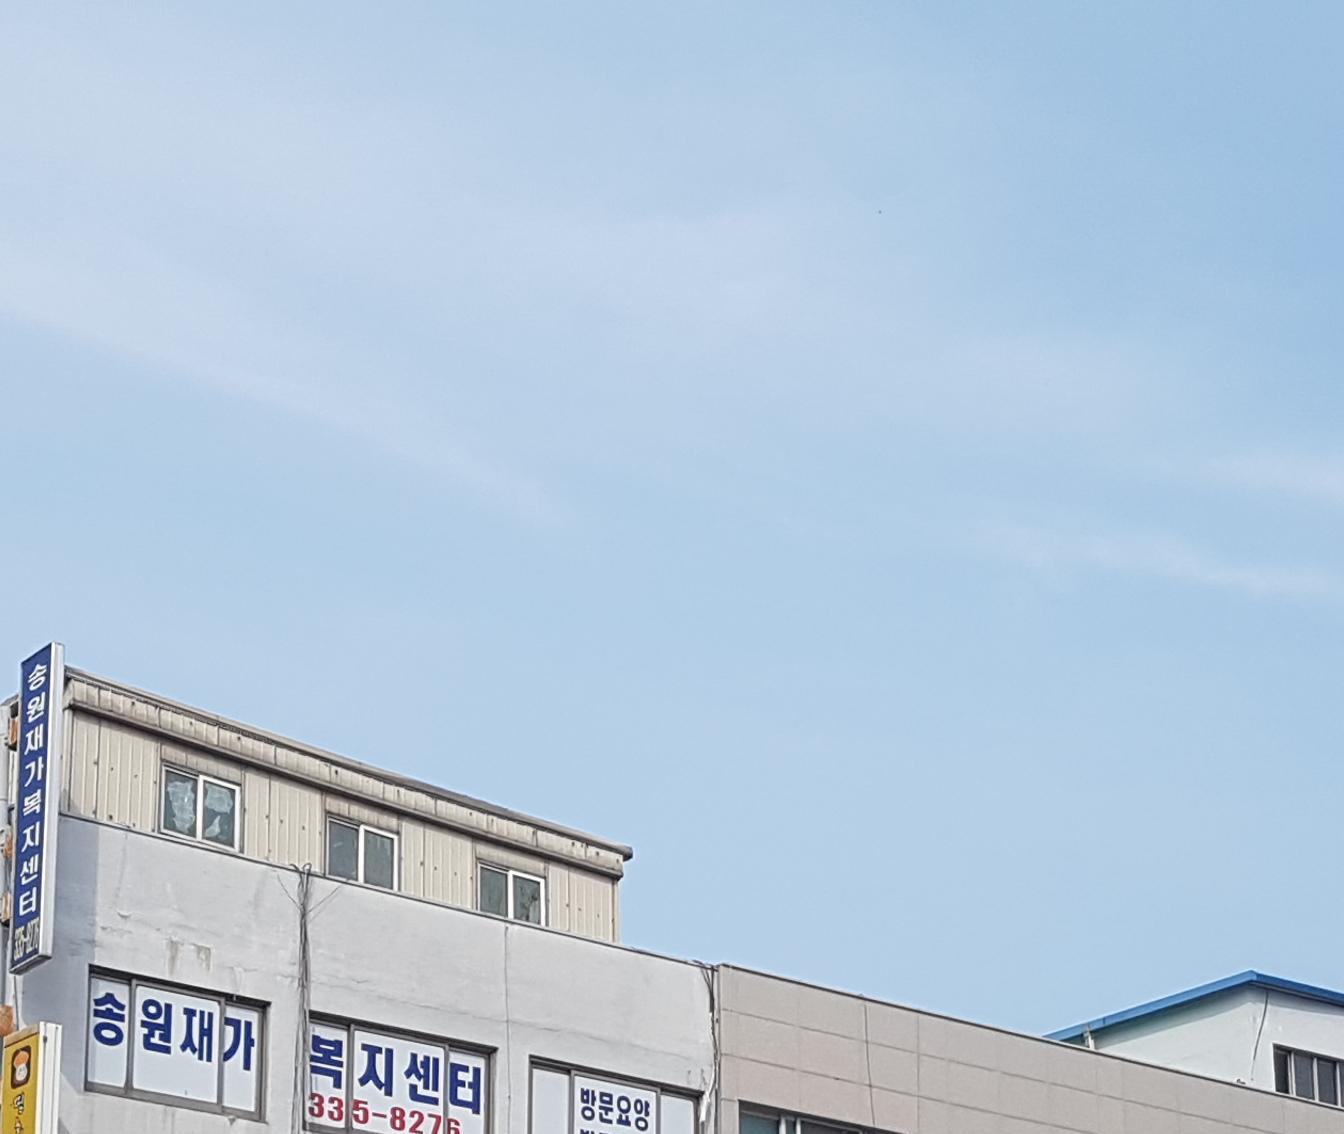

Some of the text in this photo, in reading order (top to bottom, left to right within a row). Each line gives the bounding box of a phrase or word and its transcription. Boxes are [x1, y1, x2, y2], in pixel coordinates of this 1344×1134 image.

[18, 663, 47, 917] 송원재가복지센터
[93, 992, 255, 1071] 송원재가
[310, 1033, 482, 1115] 복지센터
[581, 1088, 650, 1132] 방문요양
